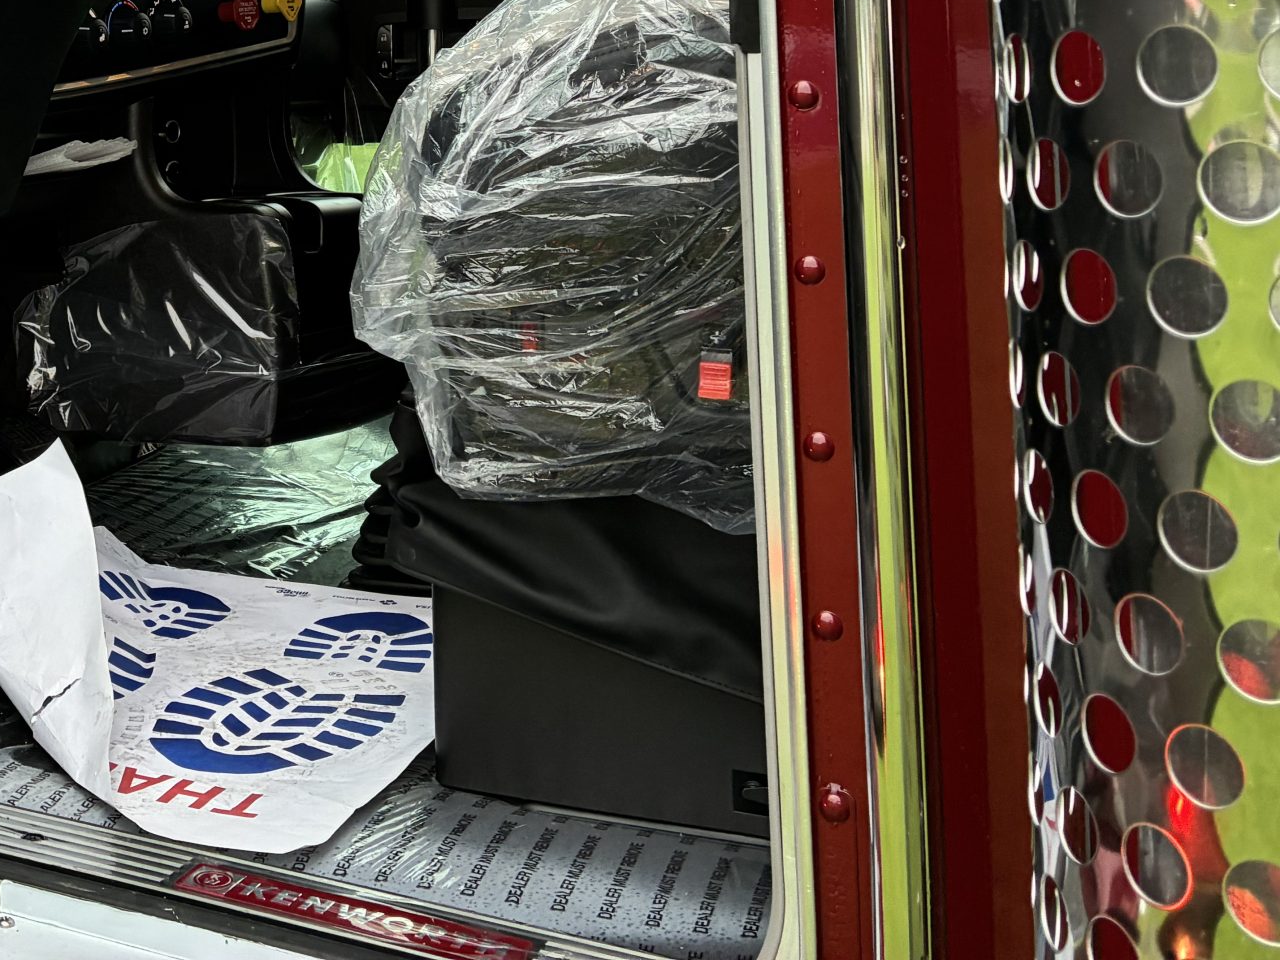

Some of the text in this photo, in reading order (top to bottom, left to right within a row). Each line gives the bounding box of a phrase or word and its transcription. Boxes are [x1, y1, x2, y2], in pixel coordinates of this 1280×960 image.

[7, 784, 33, 807] ALER
[40, 790, 67, 813] ALER
[109, 761, 264, 819] THA
[292, 845, 318, 872] DEAL
[435, 835, 459, 858] MUST
[460, 820, 518, 897] DEALER MUST REMOVE
[504, 827, 559, 905] DEALER MUST REMOVE
[550, 878, 578, 912] DEALER
[565, 859, 588, 880] MUST
[596, 888, 623, 920] DEALER
[610, 867, 632, 888] MUST
[657, 875, 678, 896] MUST
[703, 881, 723, 901] MUST
[239, 880, 512, 959] KENWORTH
[645, 893, 670, 928] DEALER
[692, 901, 717, 934] DEALER
[740, 906, 764, 939] DEALER
